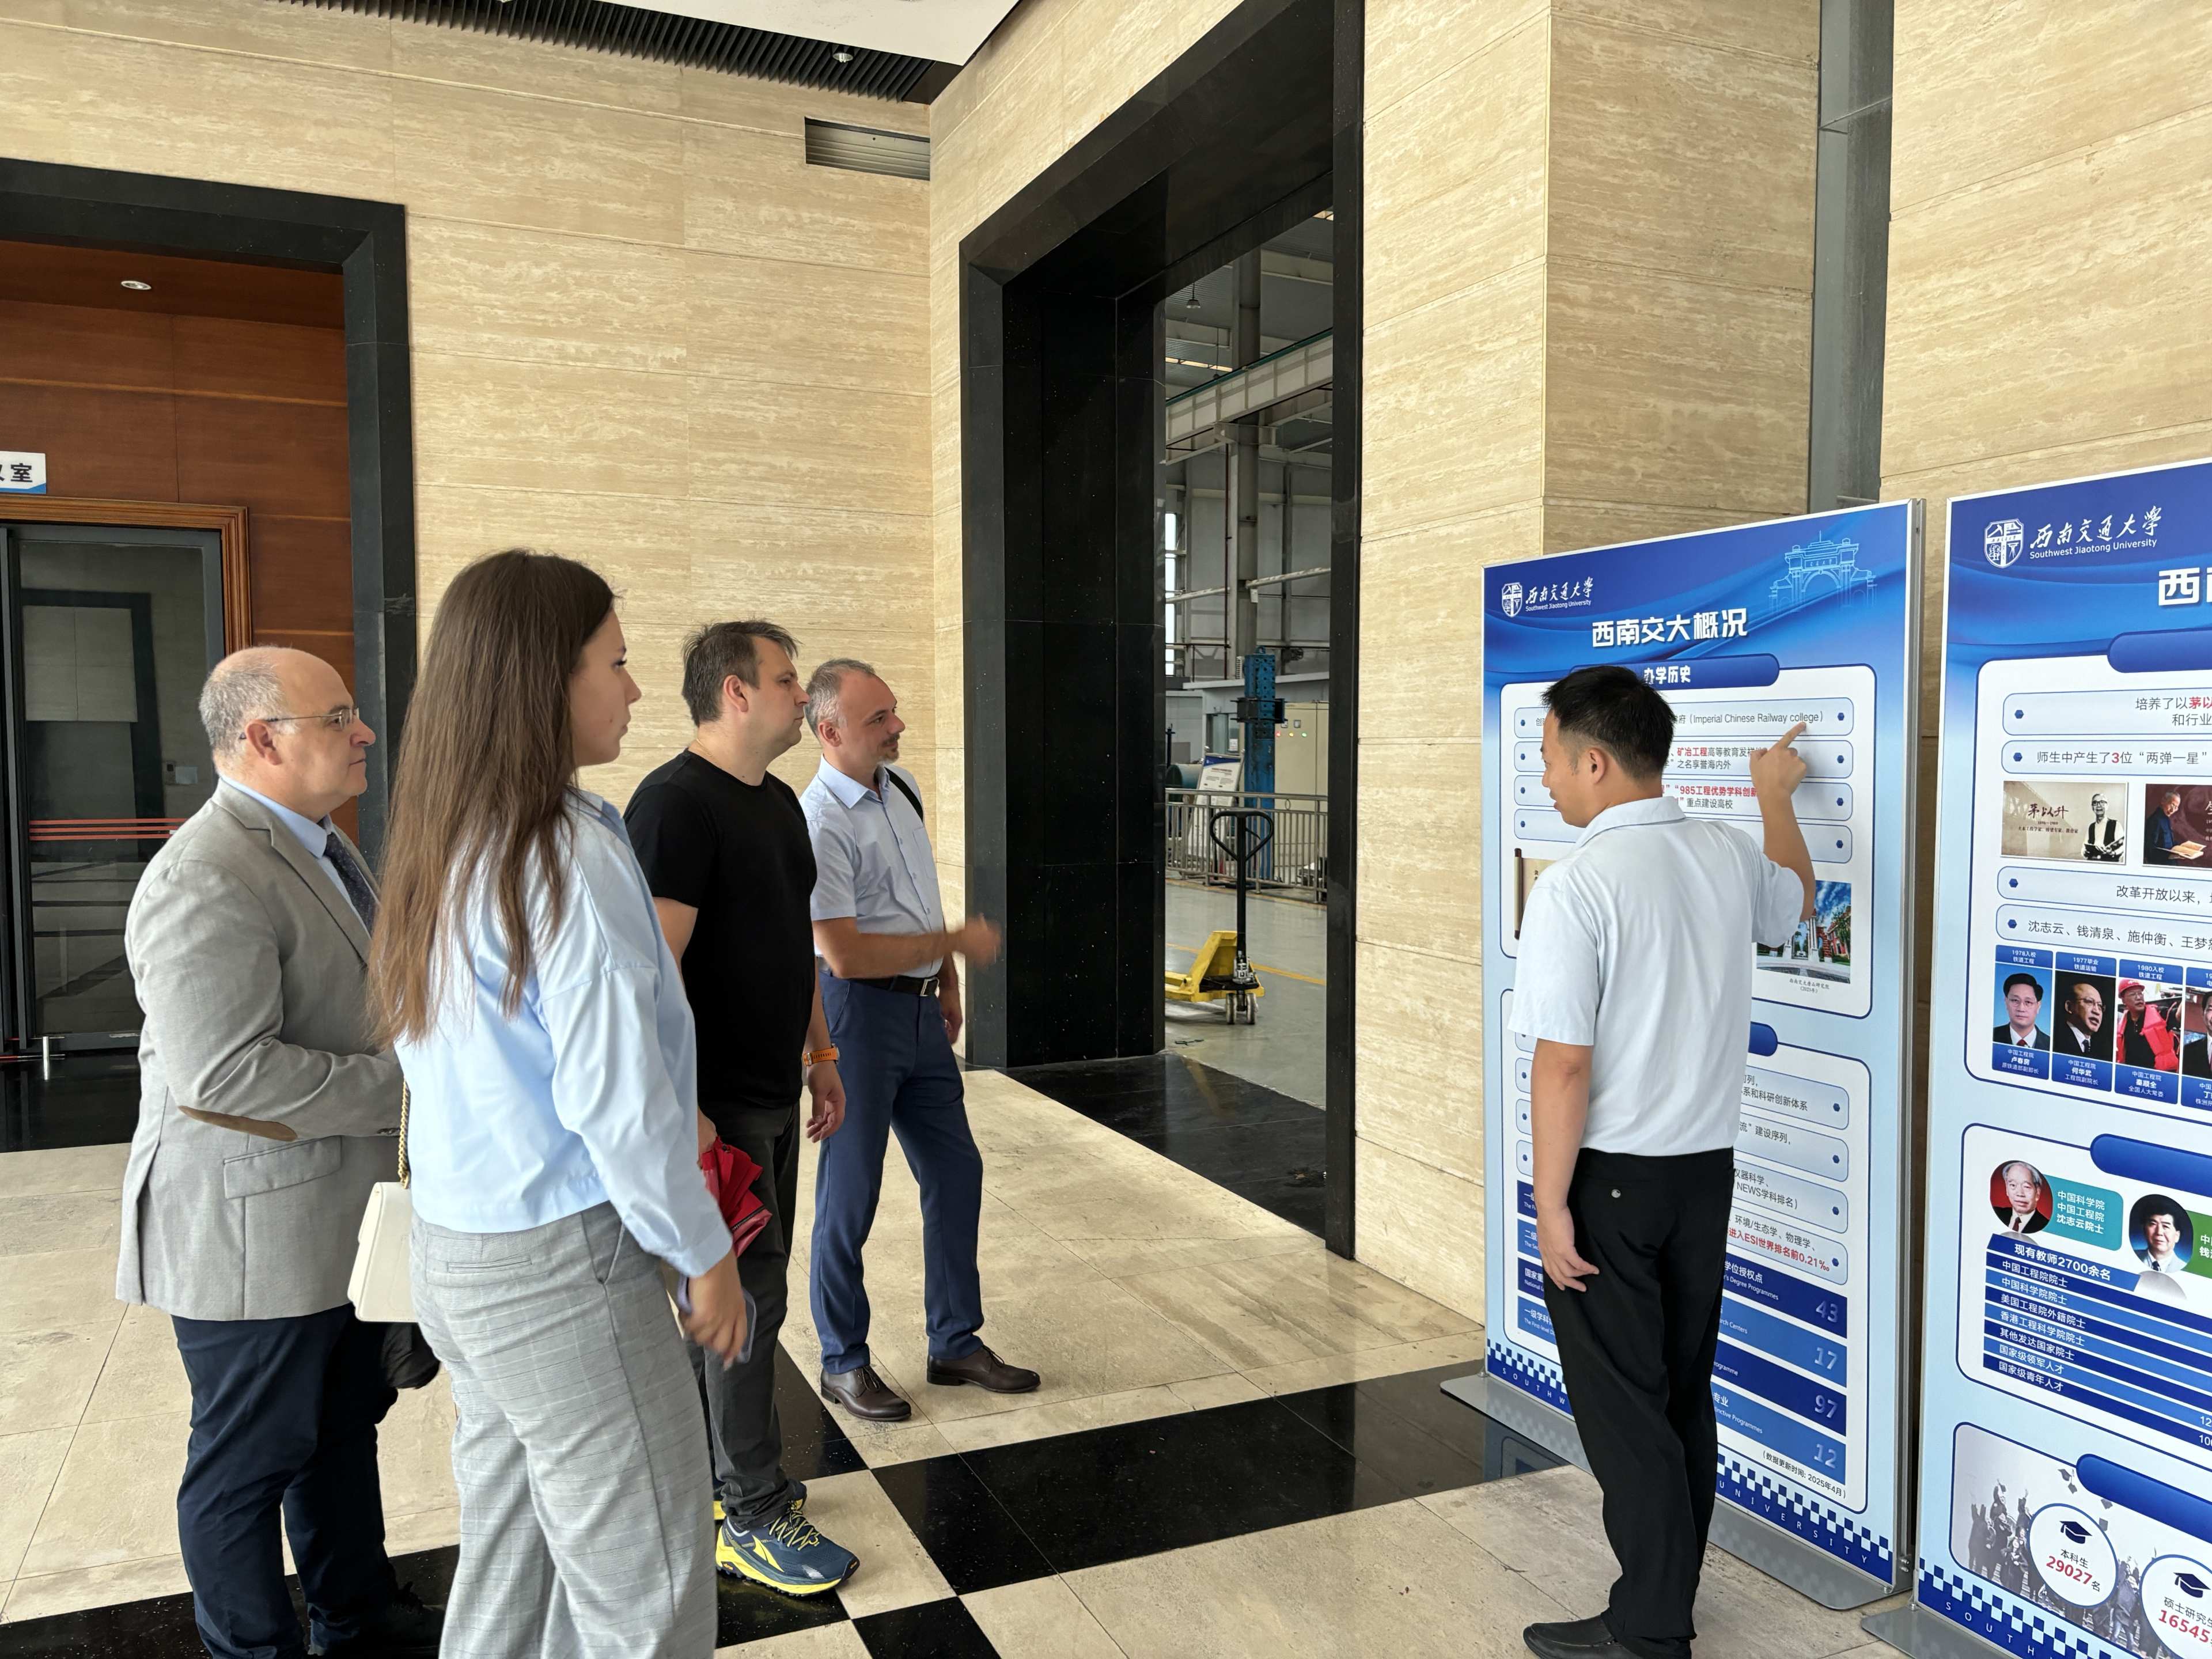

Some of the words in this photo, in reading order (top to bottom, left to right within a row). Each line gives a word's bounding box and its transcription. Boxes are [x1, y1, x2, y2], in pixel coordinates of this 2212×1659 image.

[0, 463, 33, 482] 室
[2029, 547, 2073, 559] Southwest
[2074, 543, 2111, 554] Jiaotong
[2113, 539, 2157, 550] University
[2158, 567, 2212, 606] 西
[1525, 603, 1548, 612] Southwest
[1592, 608, 1747, 647] 西南交大概况
[1644, 665, 1691, 684] 办学历史
[1725, 714, 1755, 723] Chinese
[1758, 713, 1787, 724] Railway
[2028, 804, 2069, 819] 茅以升
[2116, 885, 2212, 905] 改革开放以来，
[2138, 964, 2165, 974] 1980入校
[2008, 1048, 2035, 1058] 中国工程院
[2068, 1060, 2096, 1070] 中国工程院
[2132, 1071, 2162, 1081] 中国工程院
[1741, 1086, 1808, 1111] 系和科研创新体系
[2058, 1190, 2105, 1210] 中国科学院
[2057, 1202, 2104, 1222] 中国工程院
[2056, 1213, 2104, 1234] 沈志云院士
[2200, 1234, 2212, 1246] 中
[2014, 1243, 2111, 1281] 现有教师2700余名
[2199, 1246, 2212, 1259] 钱
[2002, 1260, 2068, 1288] 中国工程院院士
[1730, 1277, 1747, 1288] Degree
[1748, 1283, 1779, 1300] Programmes
[2001, 1277, 2068, 1305] 中国科学院院士
[1524, 1309, 1551, 1325] 一级学科
[1816, 1300, 1839, 1323] 43
[2000, 1294, 2086, 1329] 美国工程院外籍院士
[1729, 1321, 1748, 1334] Centers
[2000, 1310, 2085, 1347] 香港工程科学院院士
[1999, 1328, 2075, 1361] 其他发达国家院士
[1714, 1361, 1738, 1376] rogramme
[1815, 1347, 1838, 1370] 17
[1999, 1344, 2065, 1374] 国家级领军人才
[1502, 1368, 1566, 1404] SOUTHW
[1998, 1361, 2064, 1392] 国家级青年人才
[1815, 1395, 1838, 1419] 97
[1732, 1414, 1763, 1434] Programmes
[2199, 1435, 2212, 1447] 10
[1814, 1444, 1837, 1469] 12
[2061, 1548, 2088, 1569] 本科生
[2158, 1609, 2212, 1645] 16545
